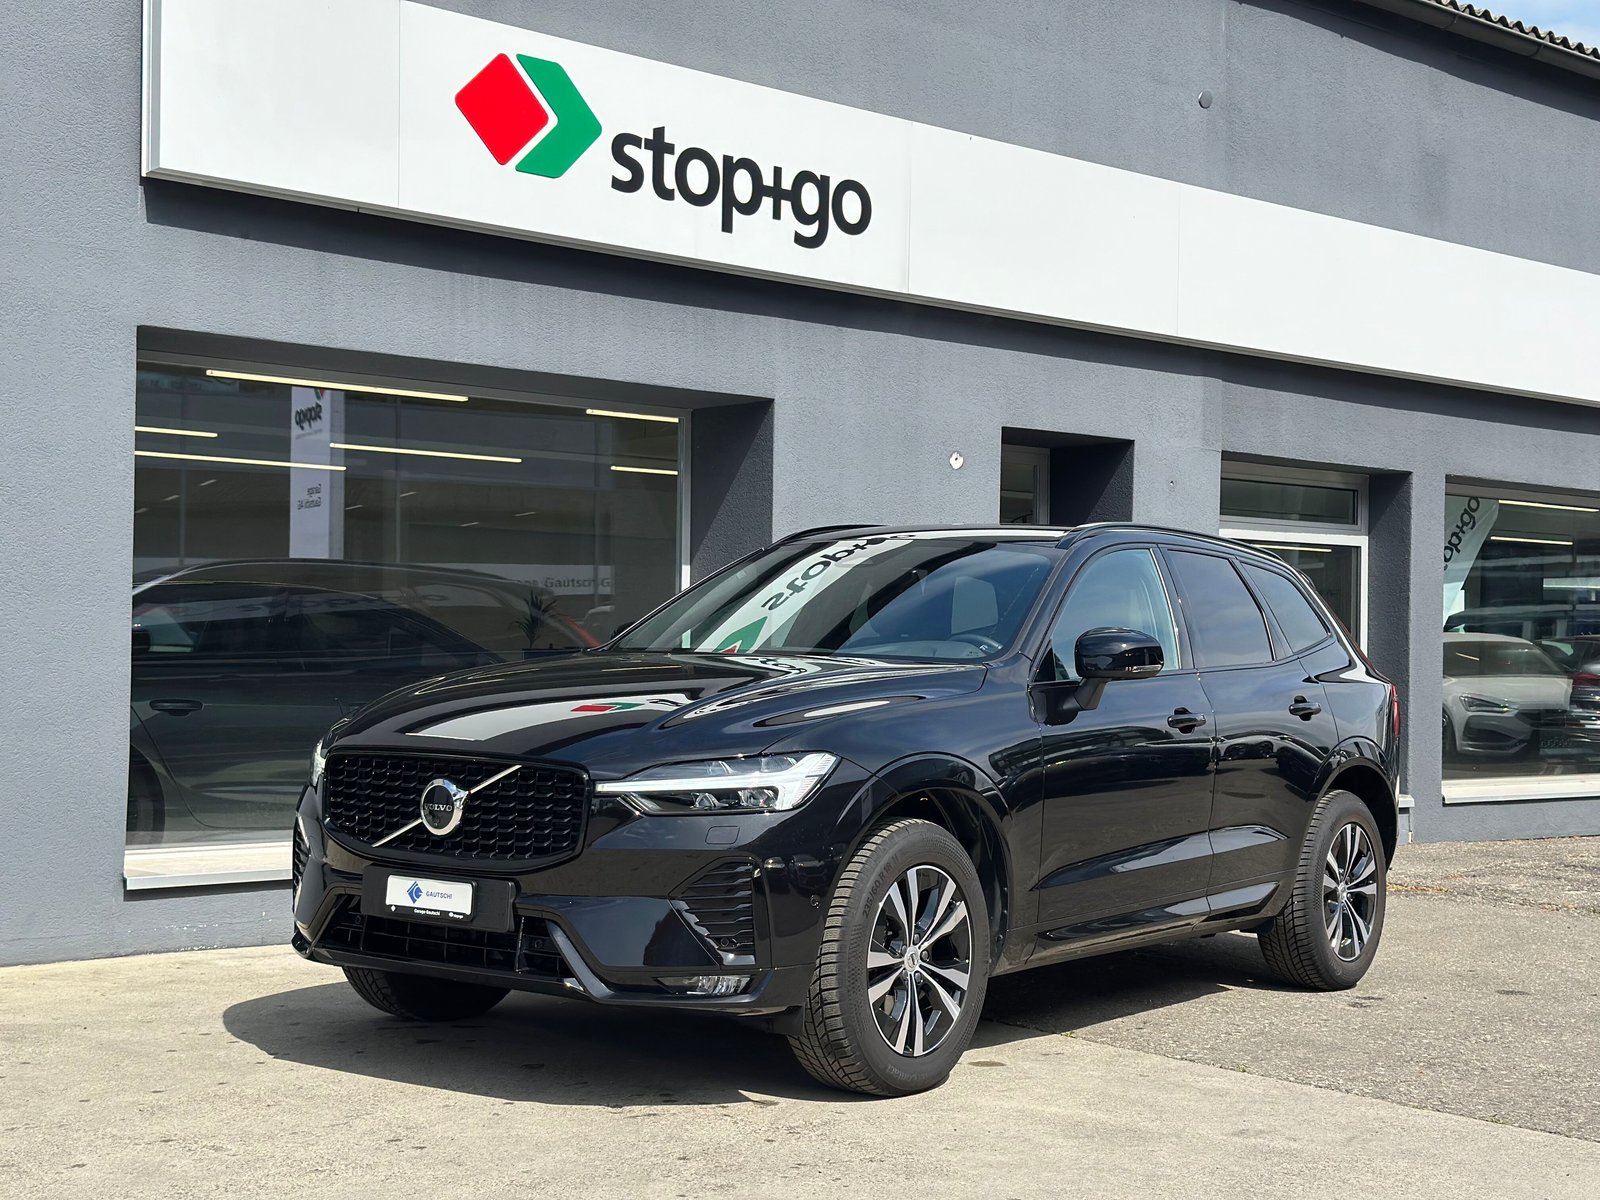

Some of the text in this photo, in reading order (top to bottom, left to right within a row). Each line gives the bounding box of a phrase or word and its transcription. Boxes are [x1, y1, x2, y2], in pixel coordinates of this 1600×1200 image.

[611, 126, 872, 248] stop+go
[1444, 497, 1480, 571] op+go
[424, 803, 453, 812] VOLVO
[425, 890, 453, 900] GAUTSCHI
